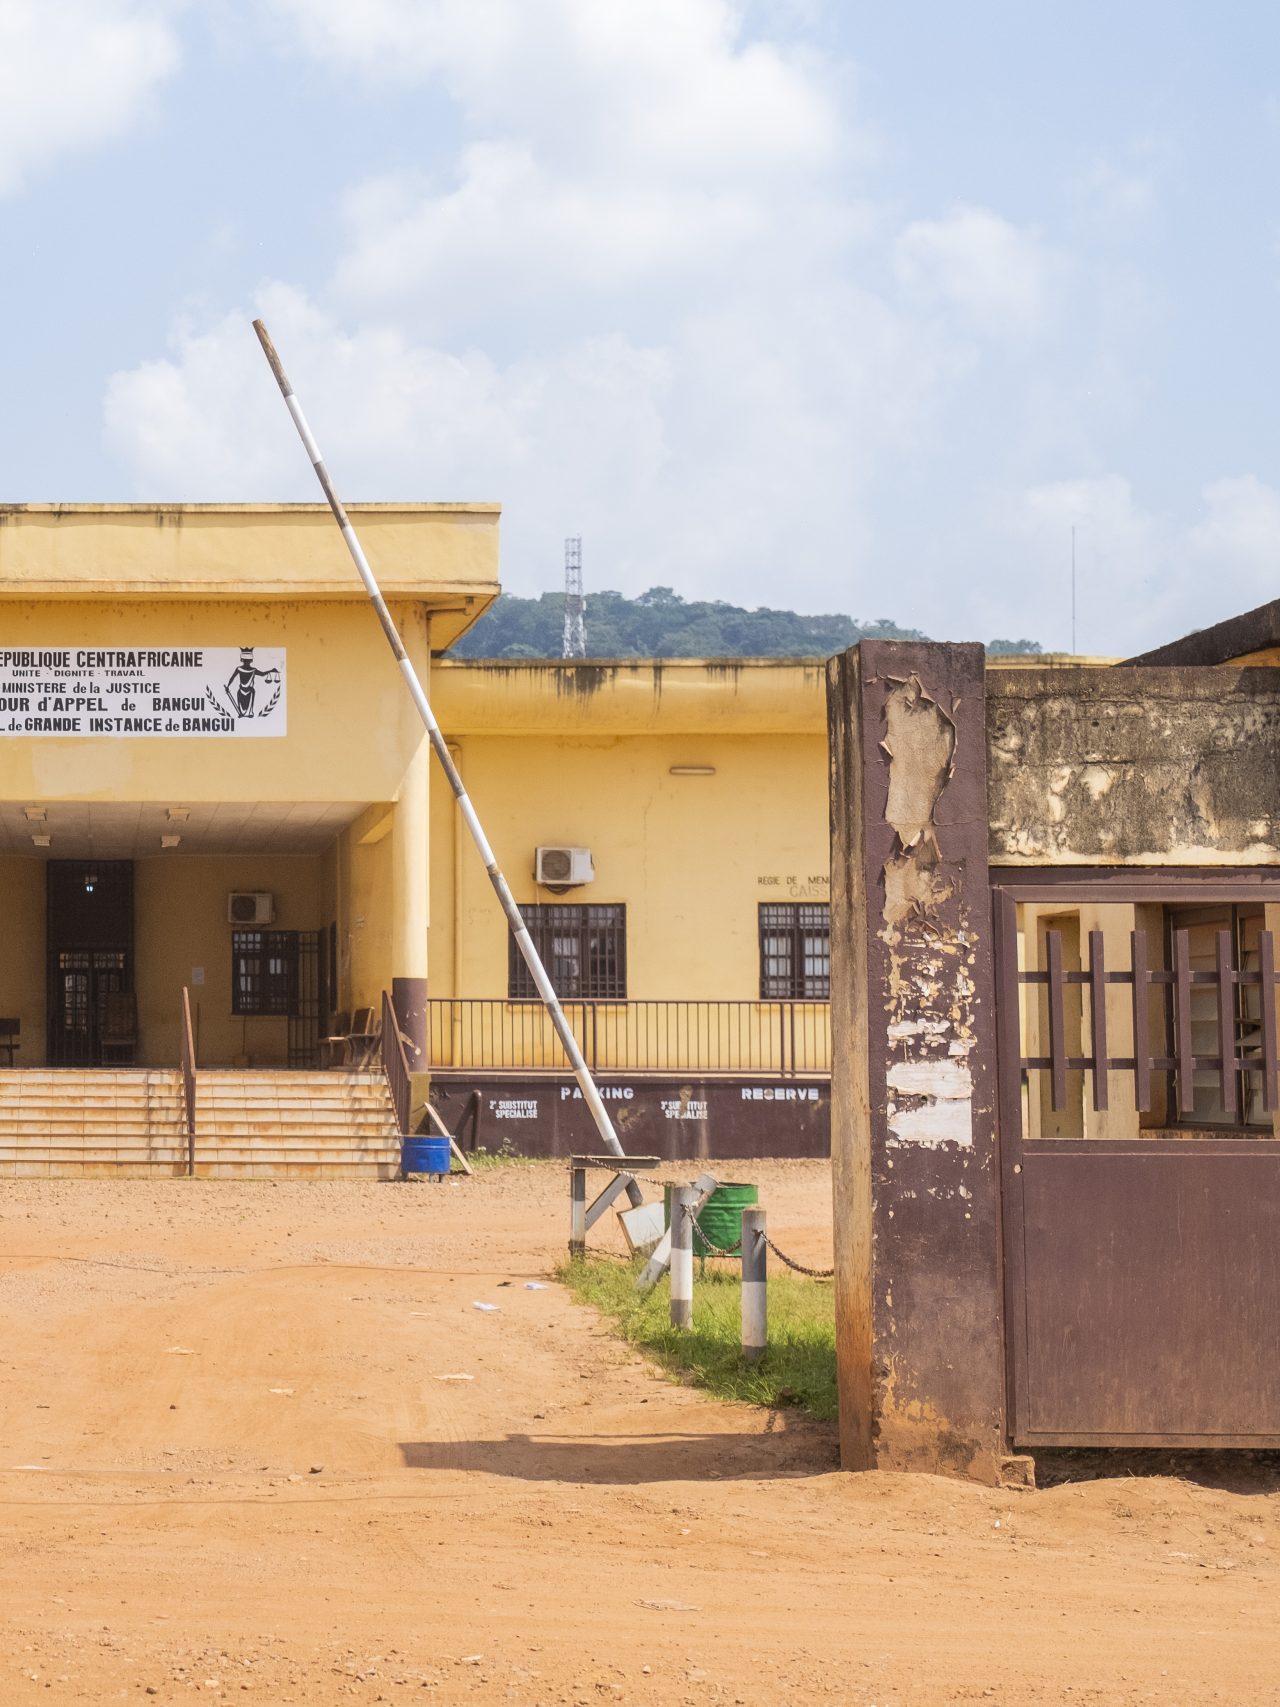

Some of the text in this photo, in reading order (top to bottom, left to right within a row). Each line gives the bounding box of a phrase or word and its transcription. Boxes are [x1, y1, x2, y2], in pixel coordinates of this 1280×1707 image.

[76, 650, 203, 668] CENTRAFRICAINE
[12, 669, 41, 677] UNITE
[54, 669, 95, 677] DIGNITE
[104, 669, 146, 677] TRAVAIL
[2, 681, 161, 694] MINISTERE de la JUSTICE
[37, 696, 108, 712] d'APPEL
[120, 697, 136, 711] de
[152, 697, 205, 711] BANGUI
[8, 717, 23, 731] de
[24, 717, 82, 732] GRANDE
[89, 717, 163, 732] INSTANCE
[165, 717, 180, 732] de
[182, 717, 235, 732] BANGUI
[786, 876, 798, 885] DE
[807, 876, 830, 885] MEN
[560, 1087, 634, 1100] PAKING
[498, 1100, 538, 1109] SUBSTITUT
[495, 1109, 538, 1119] SPECIALISE
